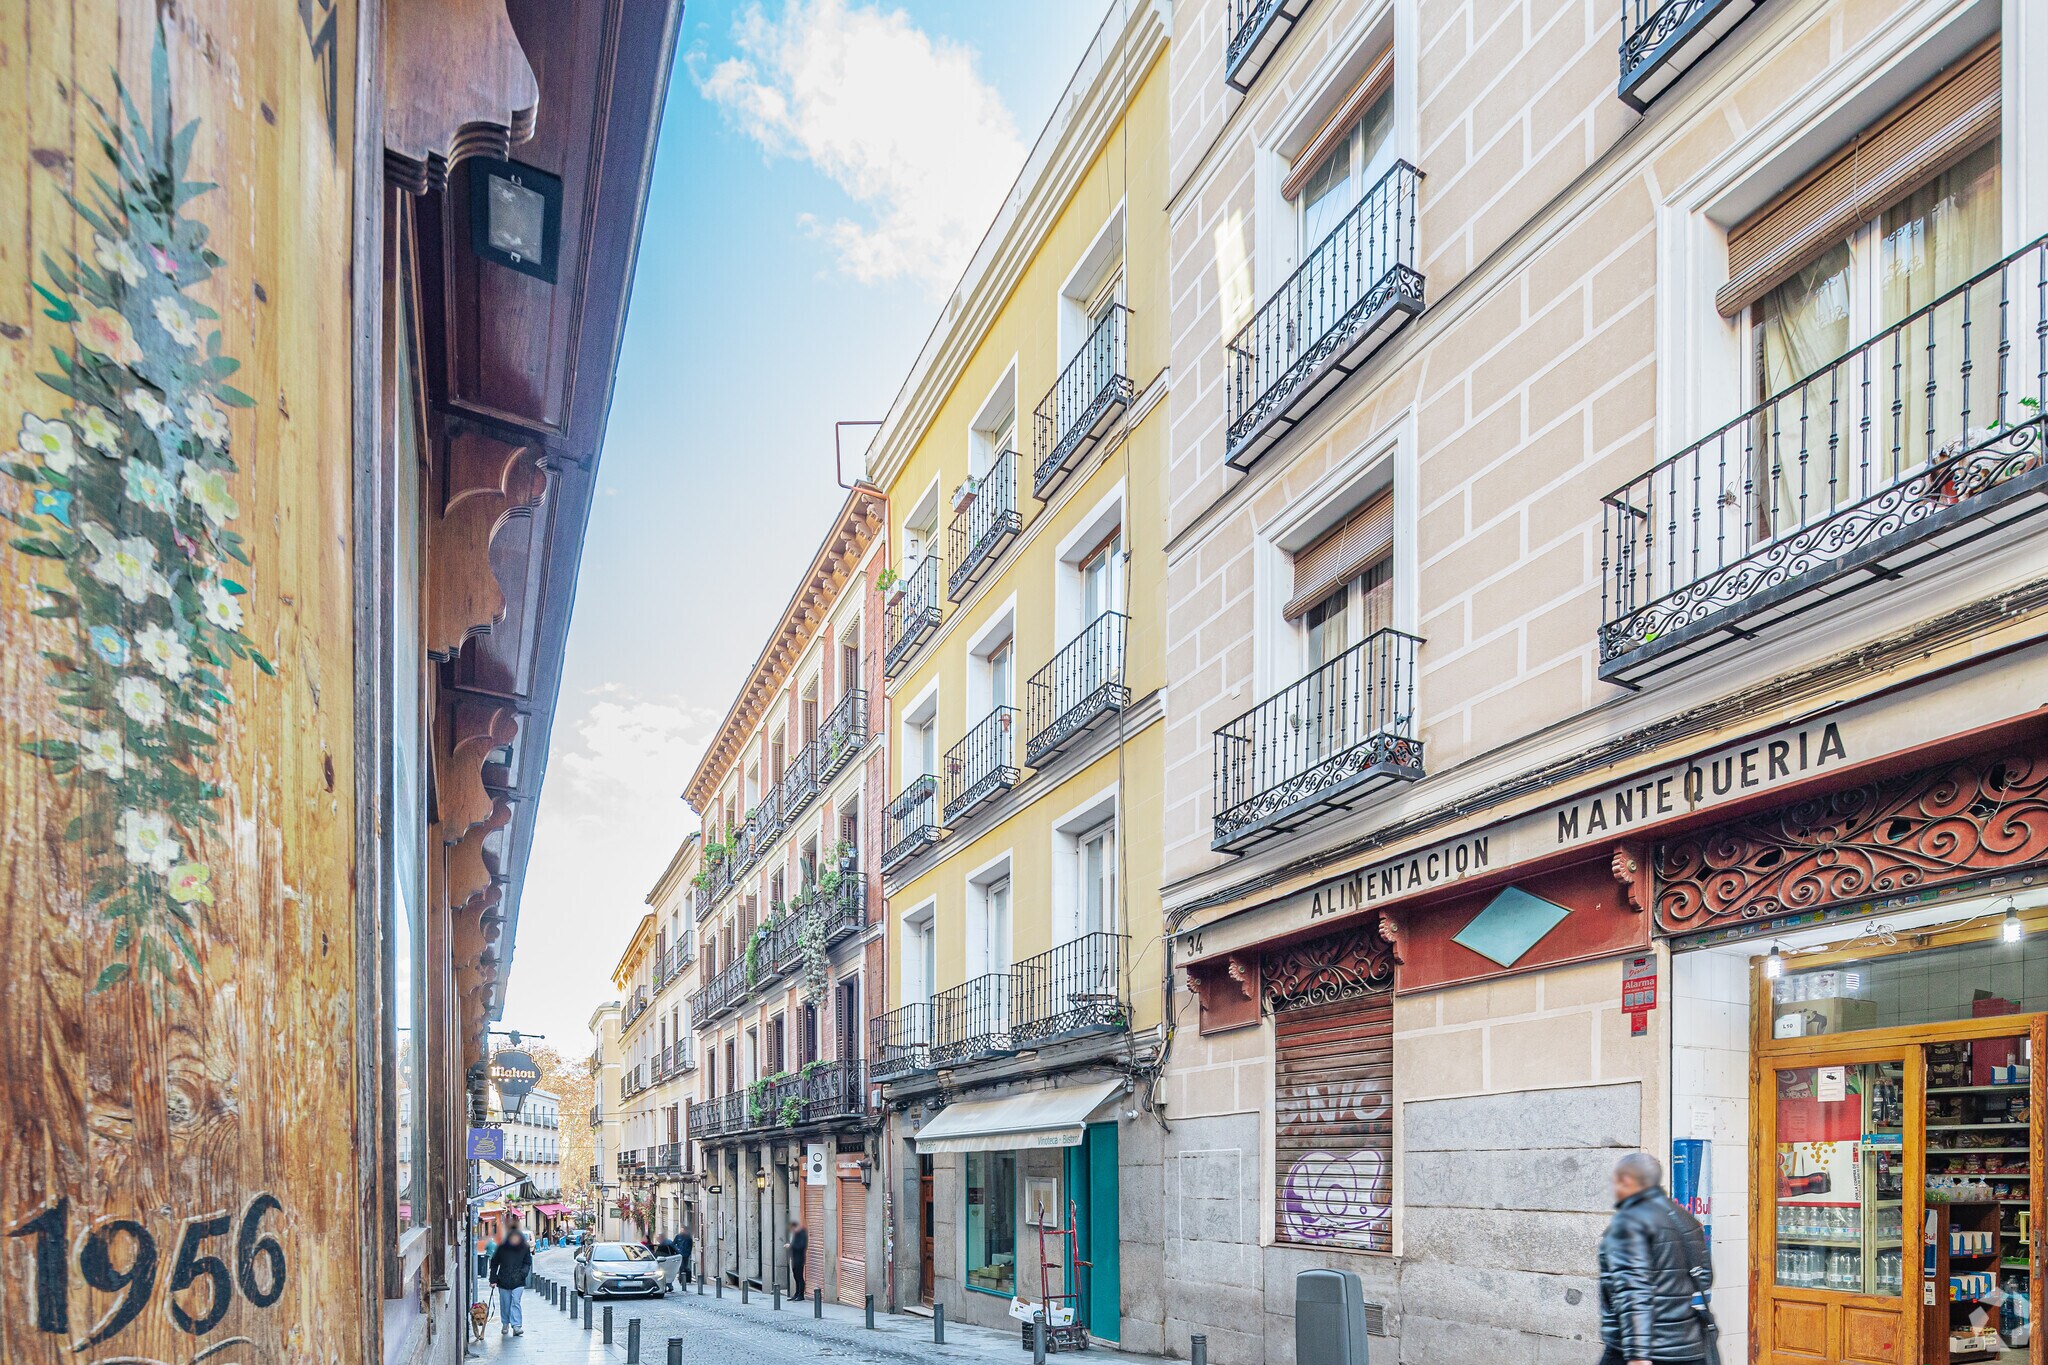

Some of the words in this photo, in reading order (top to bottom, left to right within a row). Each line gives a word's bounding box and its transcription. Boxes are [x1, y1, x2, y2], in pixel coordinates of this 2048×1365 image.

[1558, 721, 1846, 843] MANTEQUERIA
[1311, 836, 1489, 919] ALIMENTACION
[1187, 933, 1203, 957] 34
[1625, 978, 1655, 989] Alarma
[491, 1066, 535, 1079] Mahou
[1037, 1136, 1058, 1146] Vinoteca
[6, 1192, 287, 1353] 1956
